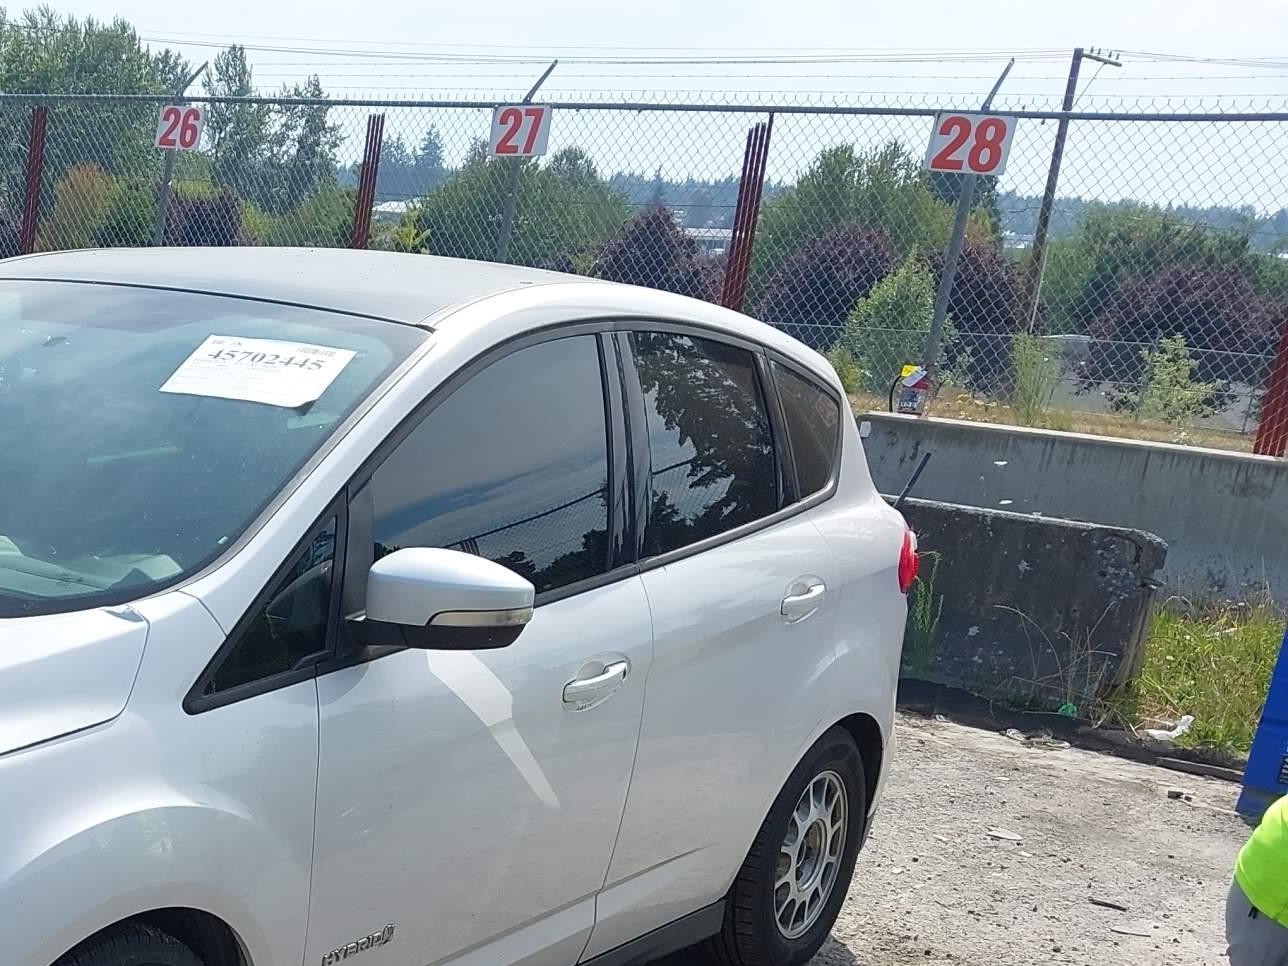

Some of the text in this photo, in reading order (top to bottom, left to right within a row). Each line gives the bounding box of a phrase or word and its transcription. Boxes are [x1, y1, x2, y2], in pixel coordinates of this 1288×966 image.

[158, 107, 201, 149] 26
[495, 107, 545, 155] 27
[930, 115, 1008, 173] 28
[207, 348, 327, 371] 45702445
